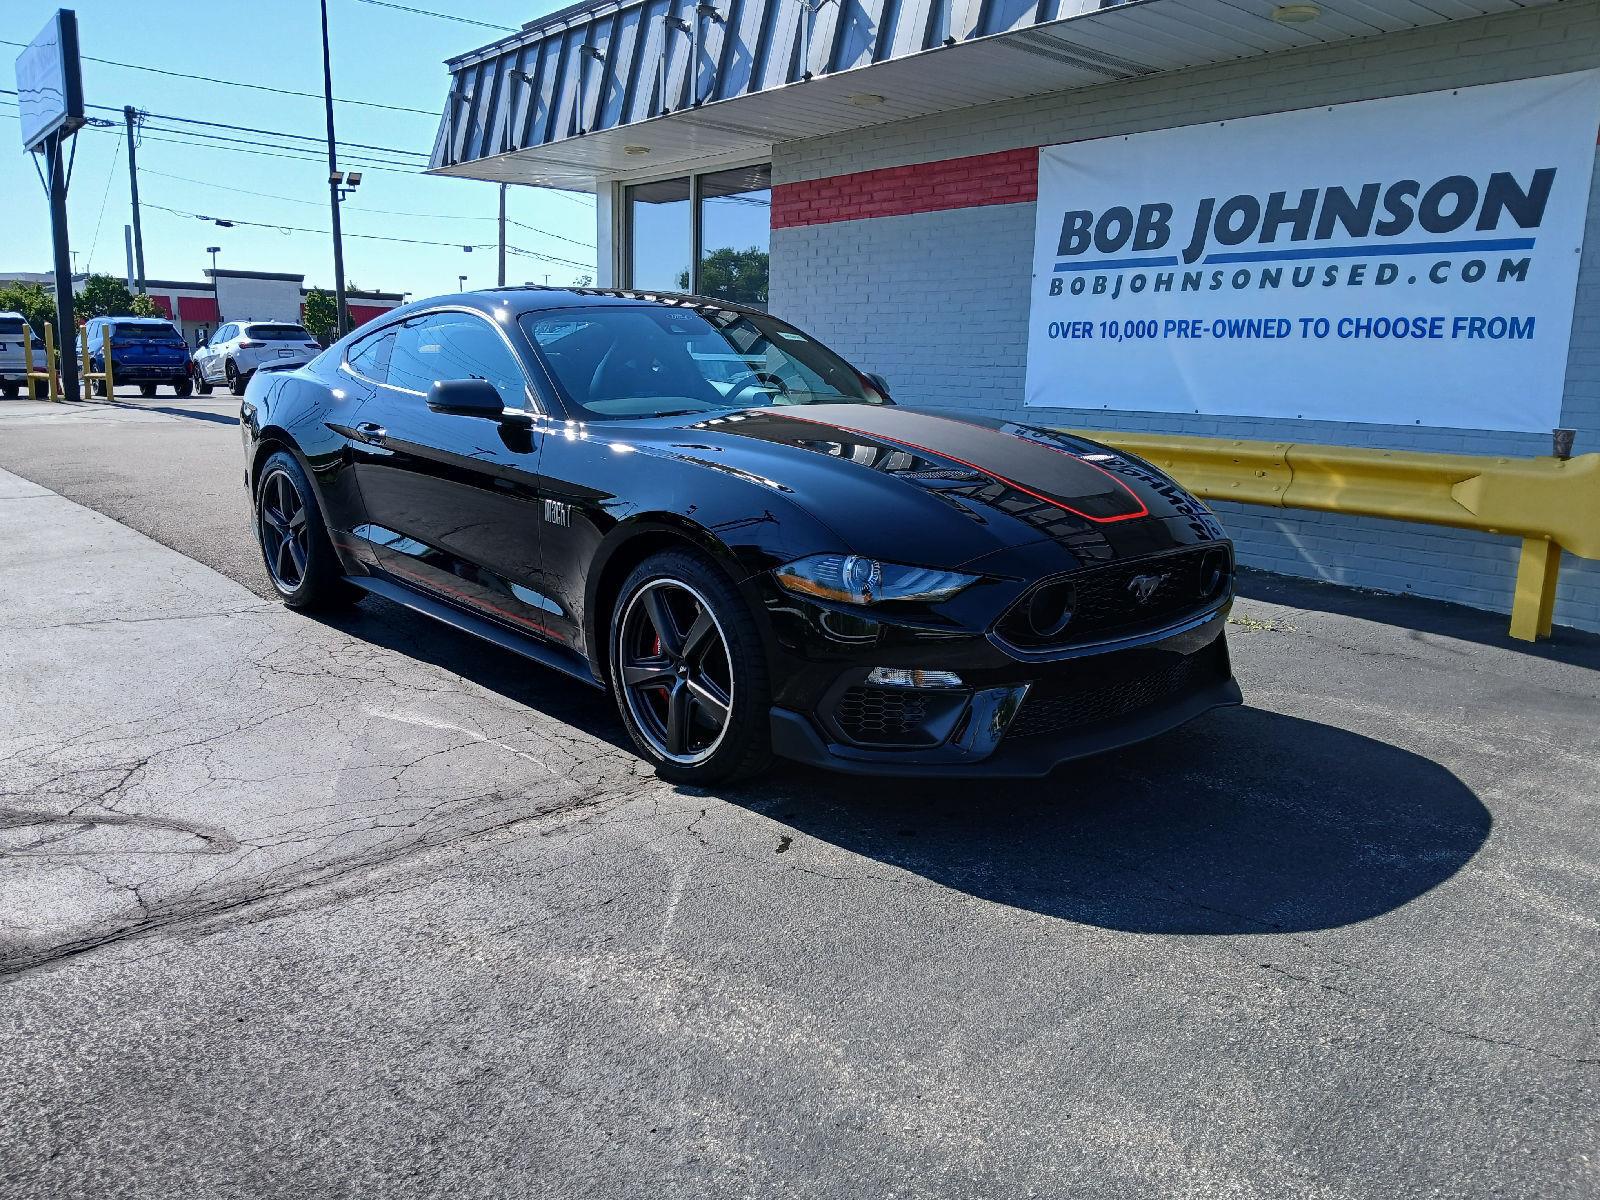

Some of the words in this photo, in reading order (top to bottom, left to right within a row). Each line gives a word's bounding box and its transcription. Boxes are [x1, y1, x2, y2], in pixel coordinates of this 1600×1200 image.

[1057, 203, 1173, 256] BOB
[1182, 168, 1557, 264] JOHNSON
[1049, 258, 1531, 299] BOBJOHNSONUSED.COM
[1048, 321, 1093, 339] OVER
[1100, 320, 1158, 342] 10,000
[1163, 318, 1291, 339] PRE-OWNED
[1299, 317, 1330, 338] TO
[1337, 317, 1445, 339] CHOOSE
[1451, 316, 1536, 340] FROM
